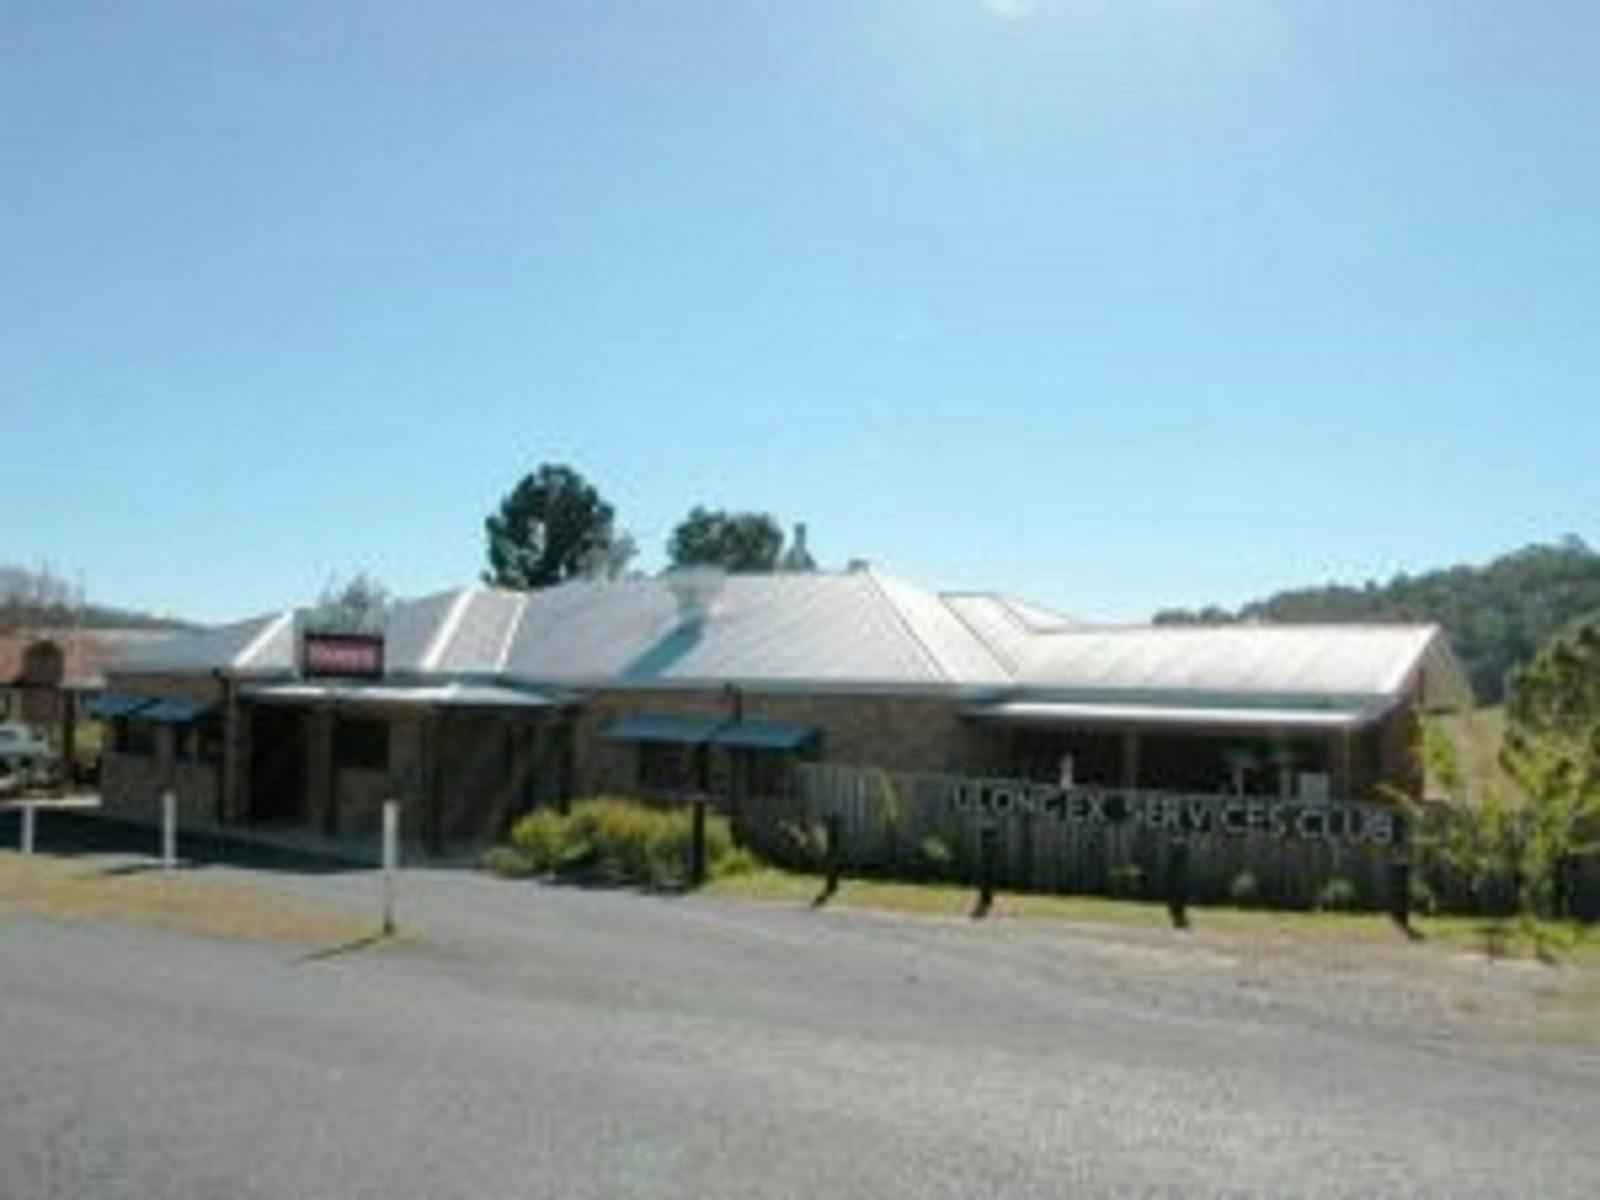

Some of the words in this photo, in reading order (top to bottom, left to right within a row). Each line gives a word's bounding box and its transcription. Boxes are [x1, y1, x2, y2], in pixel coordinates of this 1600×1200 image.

[1068, 790, 1108, 824] EX
[1123, 793, 1286, 837] SERVICES
[1297, 809, 1394, 842] CLUB
